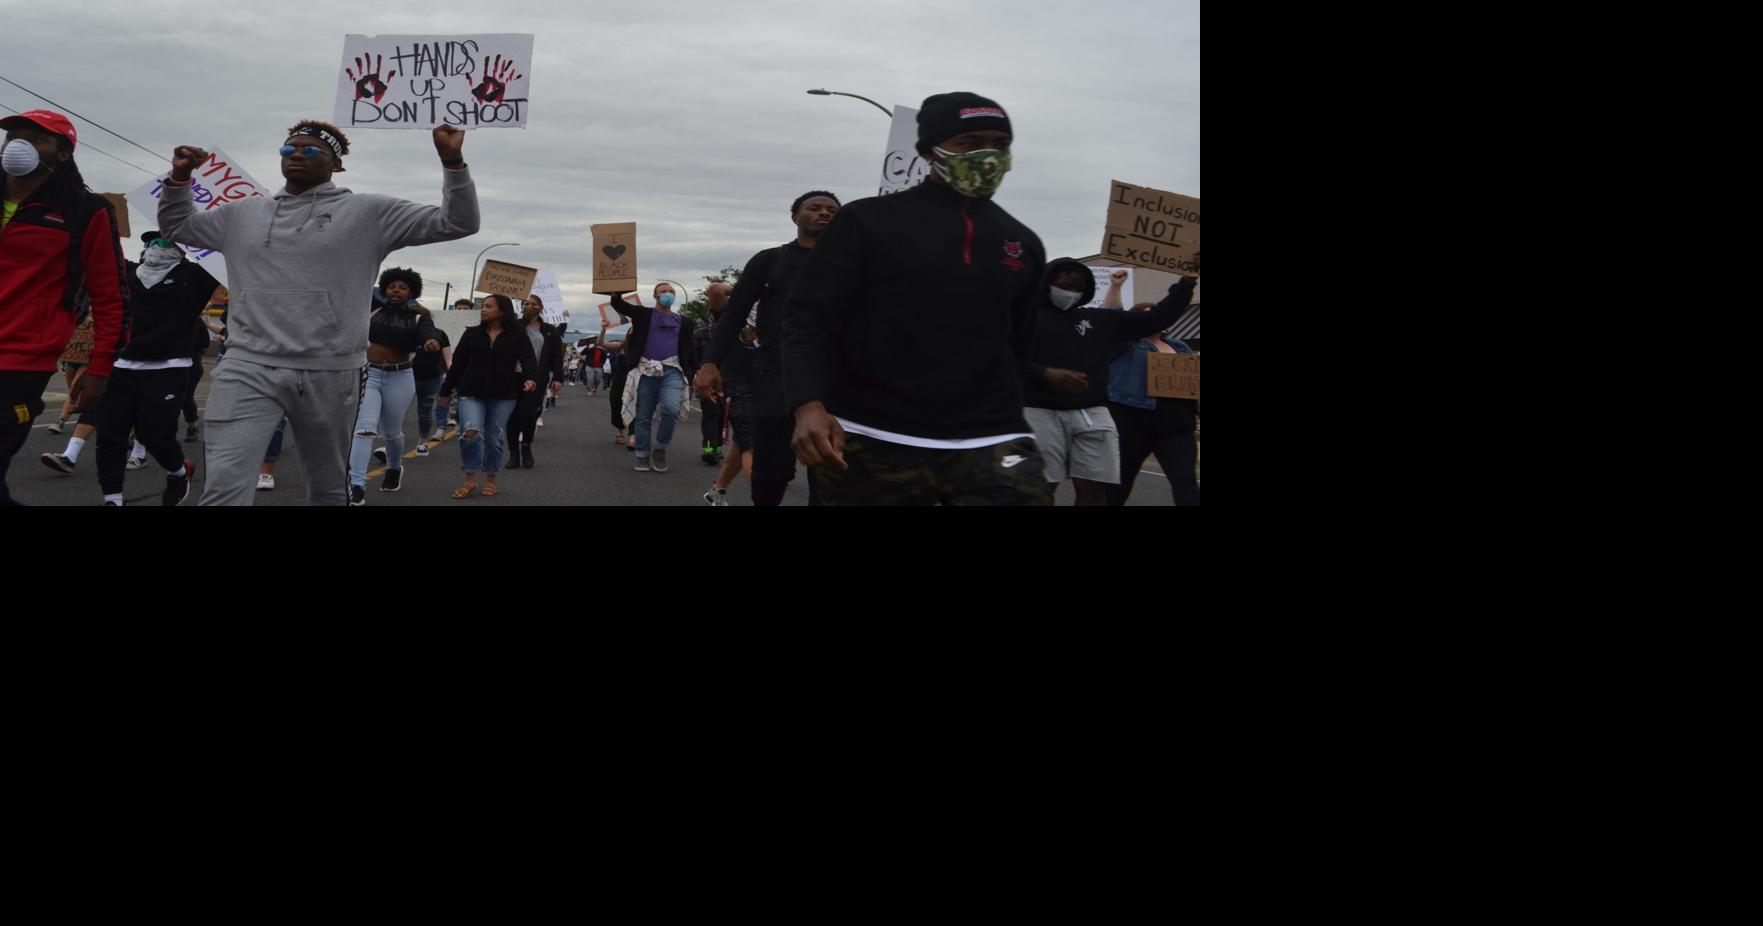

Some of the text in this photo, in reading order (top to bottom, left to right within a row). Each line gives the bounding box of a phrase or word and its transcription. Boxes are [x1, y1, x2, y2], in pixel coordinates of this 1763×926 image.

[390, 40, 479, 77] HANDS
[410, 78, 445, 96] UP
[443, 98, 528, 125] SHOOT
[1134, 215, 1183, 241] NOT
[598, 269, 629, 277] PEOPLE
[600, 262, 627, 270] BLACK
